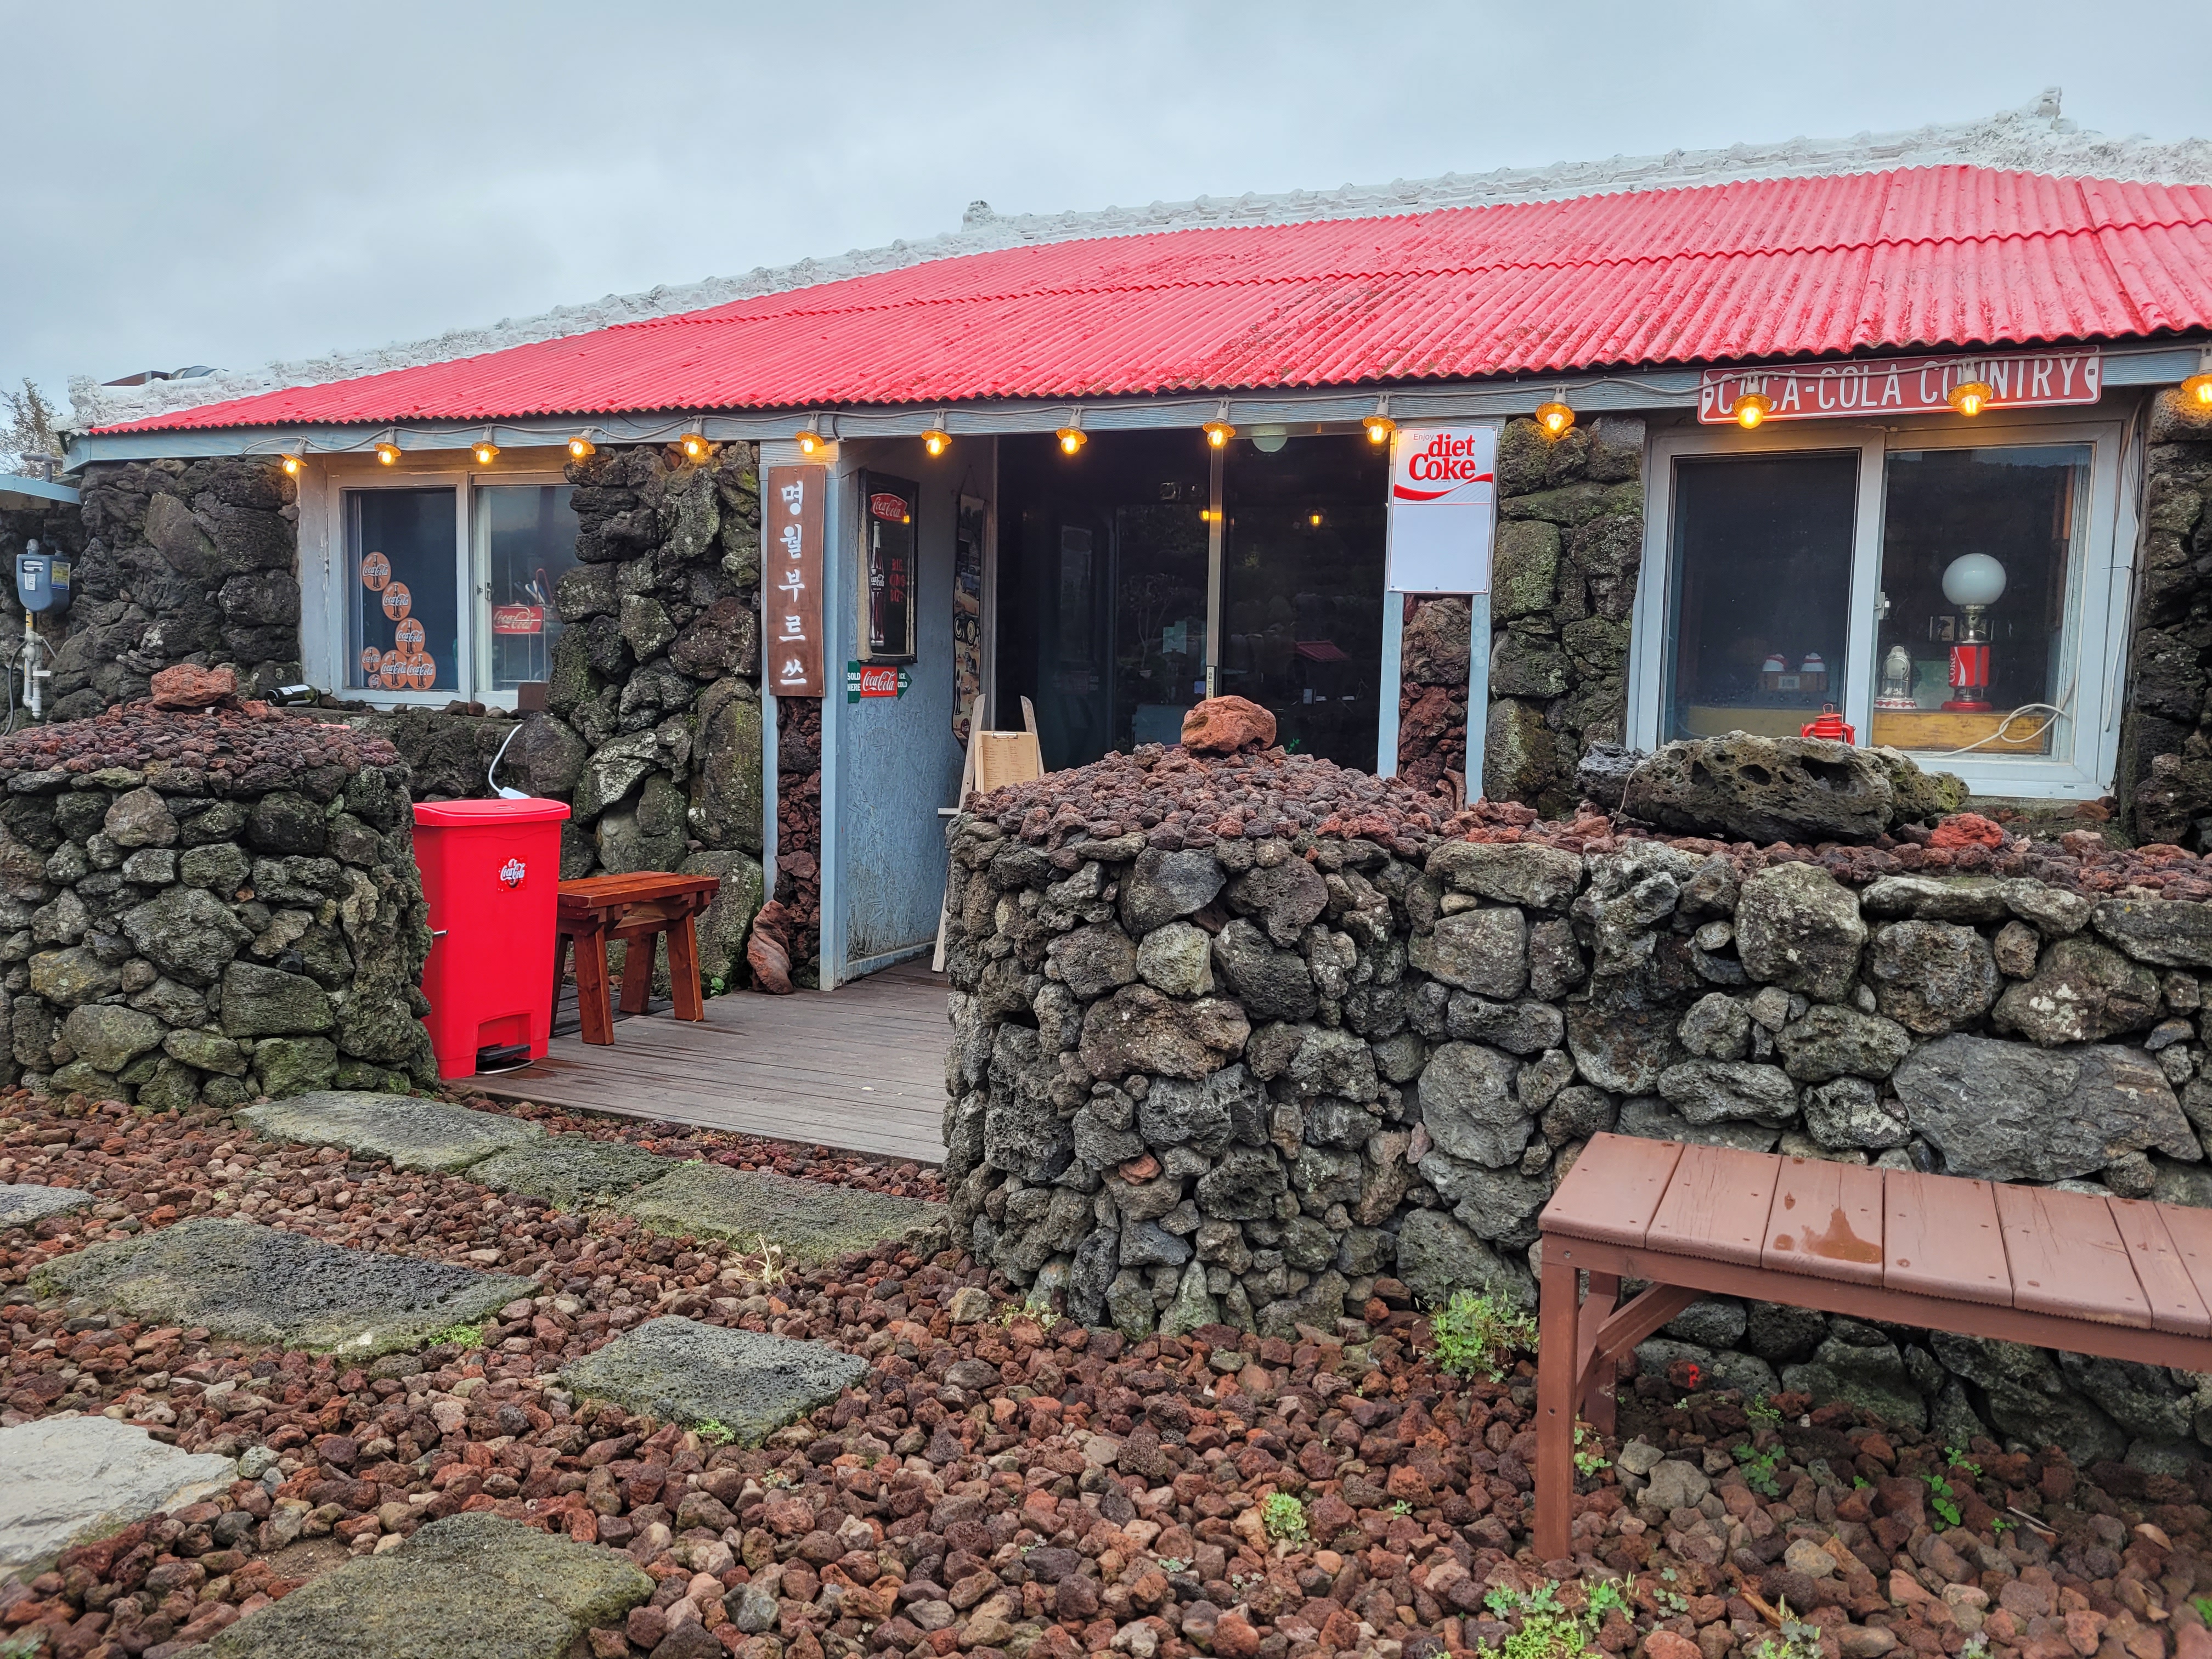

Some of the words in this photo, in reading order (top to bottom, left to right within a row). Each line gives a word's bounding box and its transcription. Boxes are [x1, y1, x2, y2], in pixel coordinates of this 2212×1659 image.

[1717, 363, 1902, 415] CCA-COLA
[1920, 351, 2081, 404] CONTRY
[1428, 433, 1476, 458] diet
[1408, 453, 1476, 481] Coke
[778, 480, 807, 685] 명월부르쓰
[847, 672, 861, 680] SOLD
[847, 683, 861, 691] HERE
[862, 670, 896, 691] Coca-Cola
